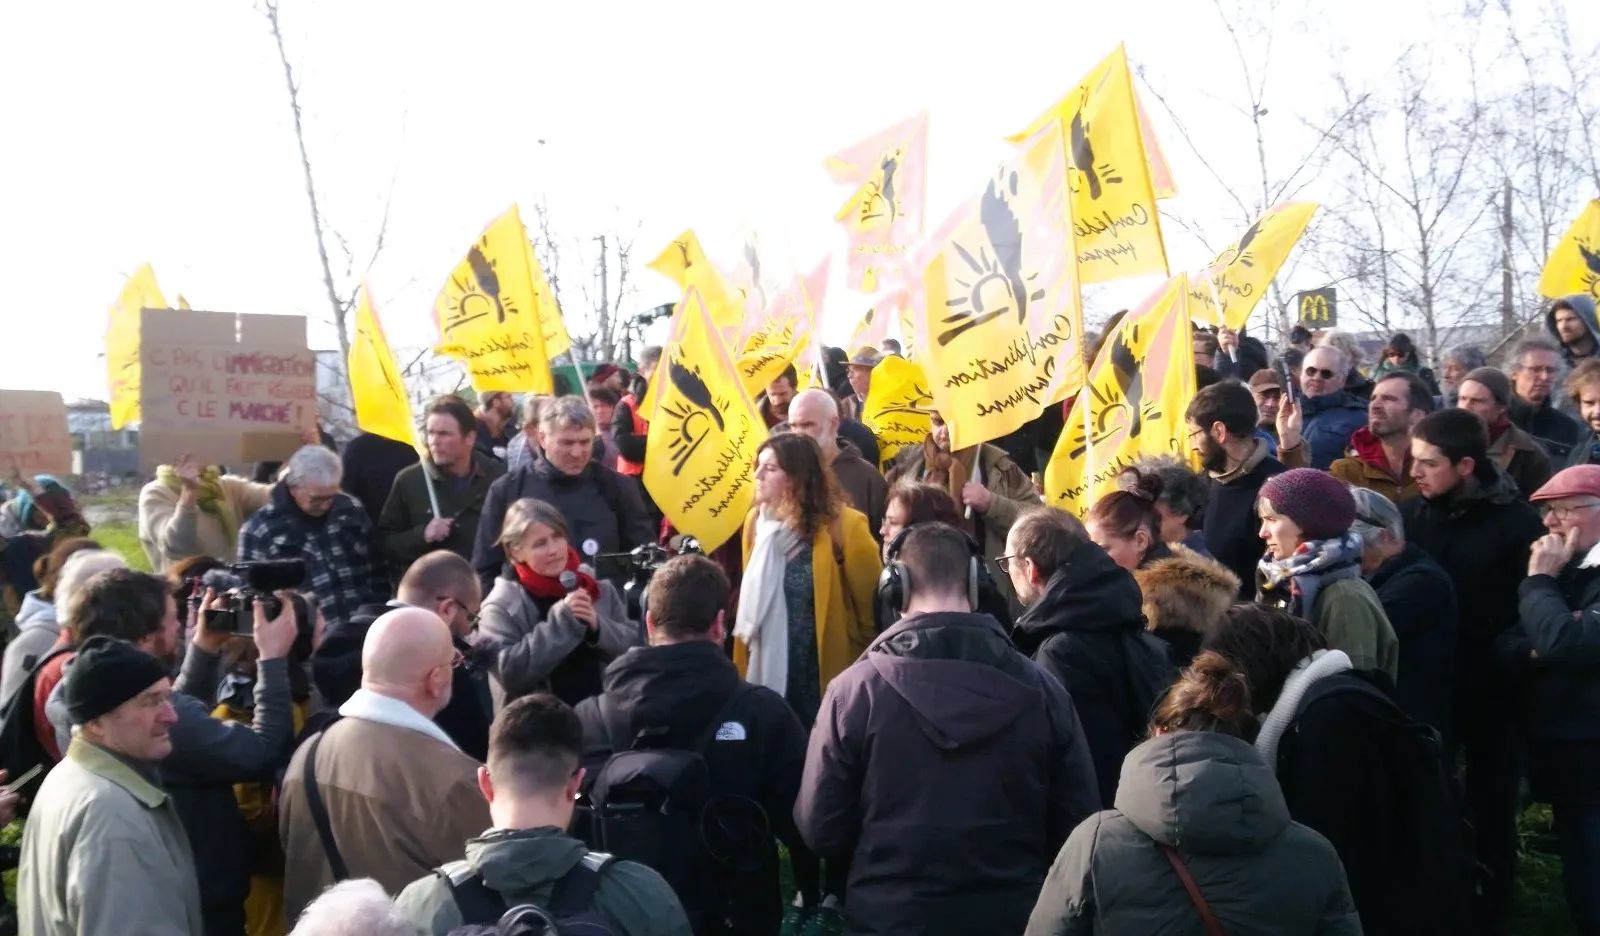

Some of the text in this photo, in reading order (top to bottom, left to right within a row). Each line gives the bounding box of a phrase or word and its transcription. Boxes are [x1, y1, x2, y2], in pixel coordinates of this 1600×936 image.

[149, 349, 166, 366] C
[172, 348, 203, 370] PAS
[176, 400, 189, 416] C
[197, 400, 218, 418] LE
[228, 401, 293, 424] MARCHÉ
